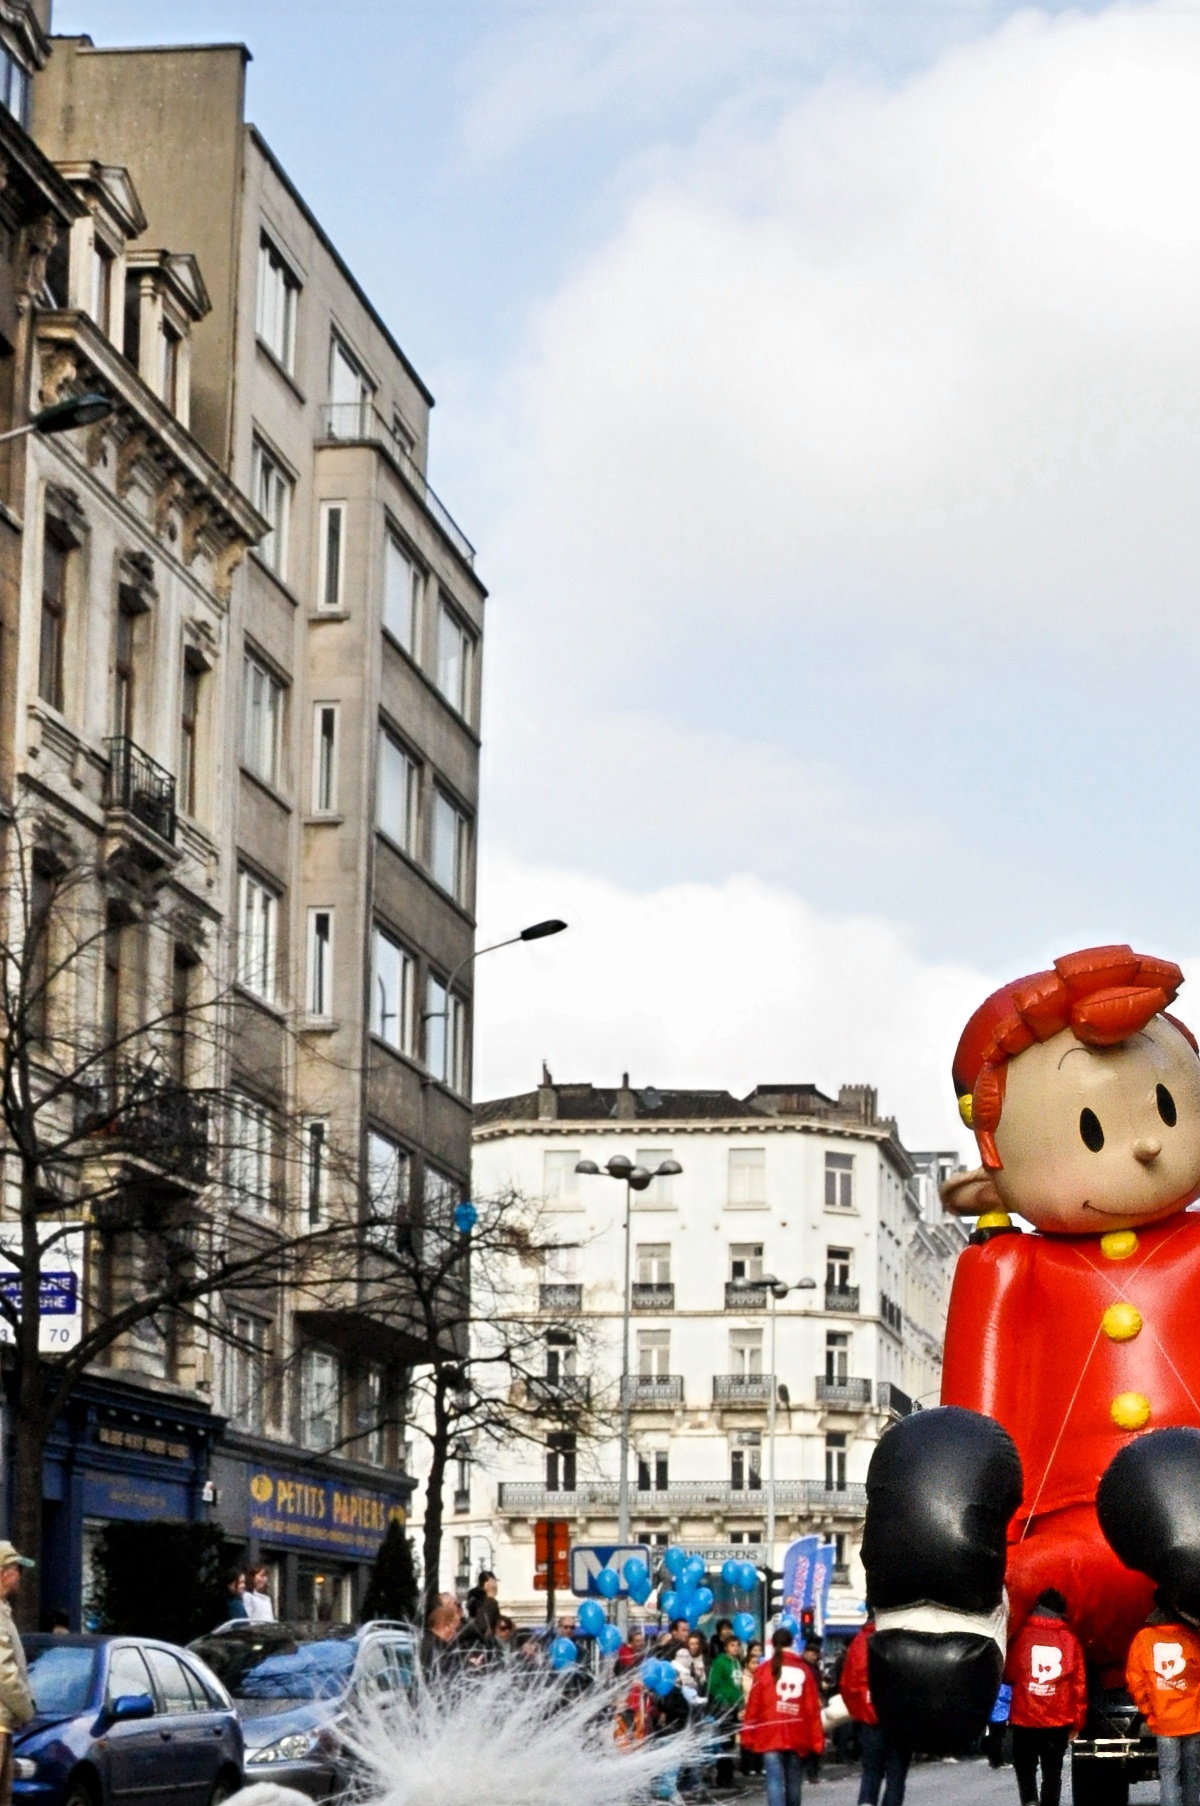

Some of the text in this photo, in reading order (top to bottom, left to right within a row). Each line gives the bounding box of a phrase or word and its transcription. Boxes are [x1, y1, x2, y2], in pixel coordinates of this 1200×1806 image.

[49, 1328, 70, 1343] 70
[276, 1479, 386, 1531] PETITS PAPIERS
